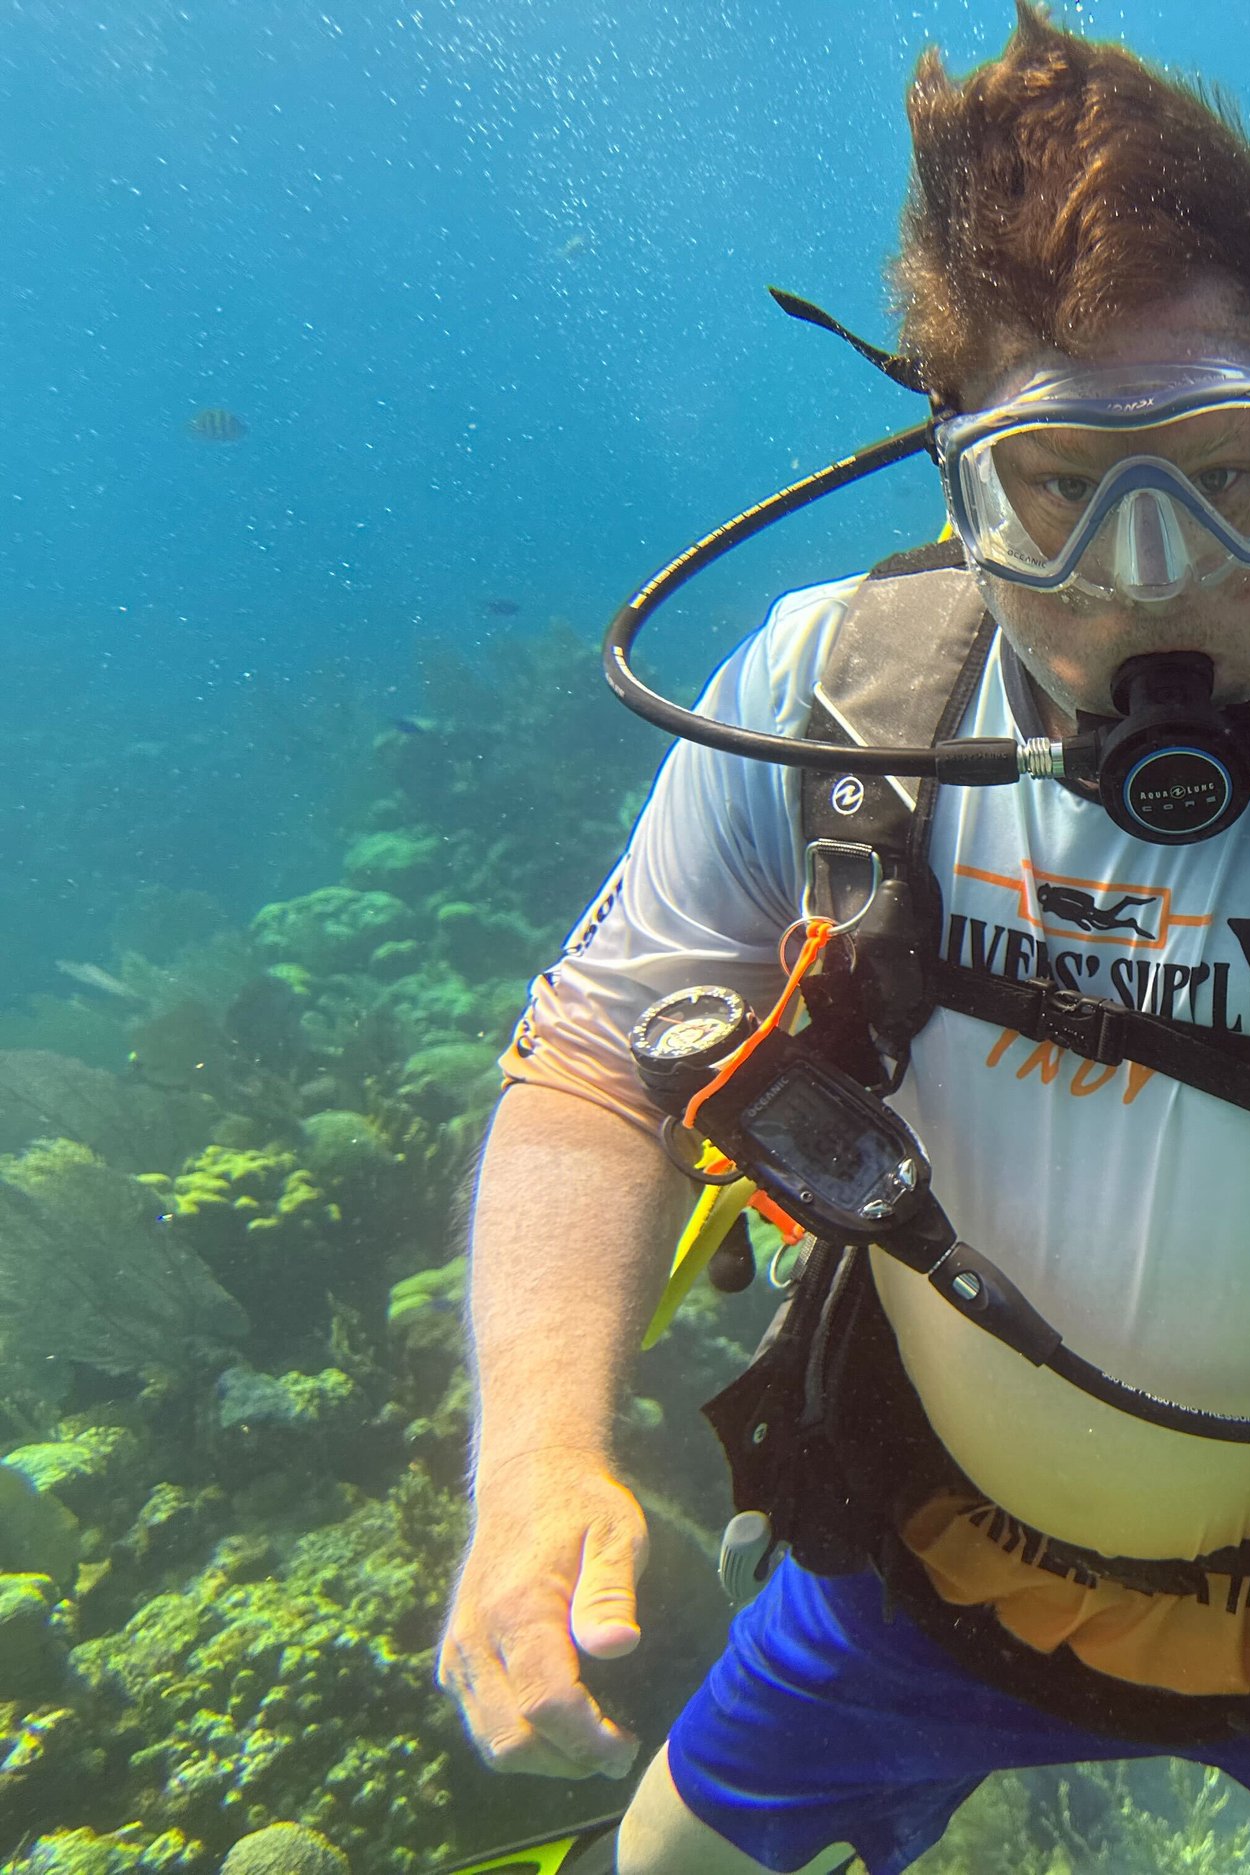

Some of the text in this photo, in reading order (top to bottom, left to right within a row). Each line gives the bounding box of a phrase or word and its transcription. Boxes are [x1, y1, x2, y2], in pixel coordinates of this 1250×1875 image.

[1007, 550, 1047, 569] OCEANIC
[1140, 783, 1215, 800] AQUA LUNG
[1142, 796, 1217, 812] CORE
[747, 1078, 790, 1117] OCEANIC
